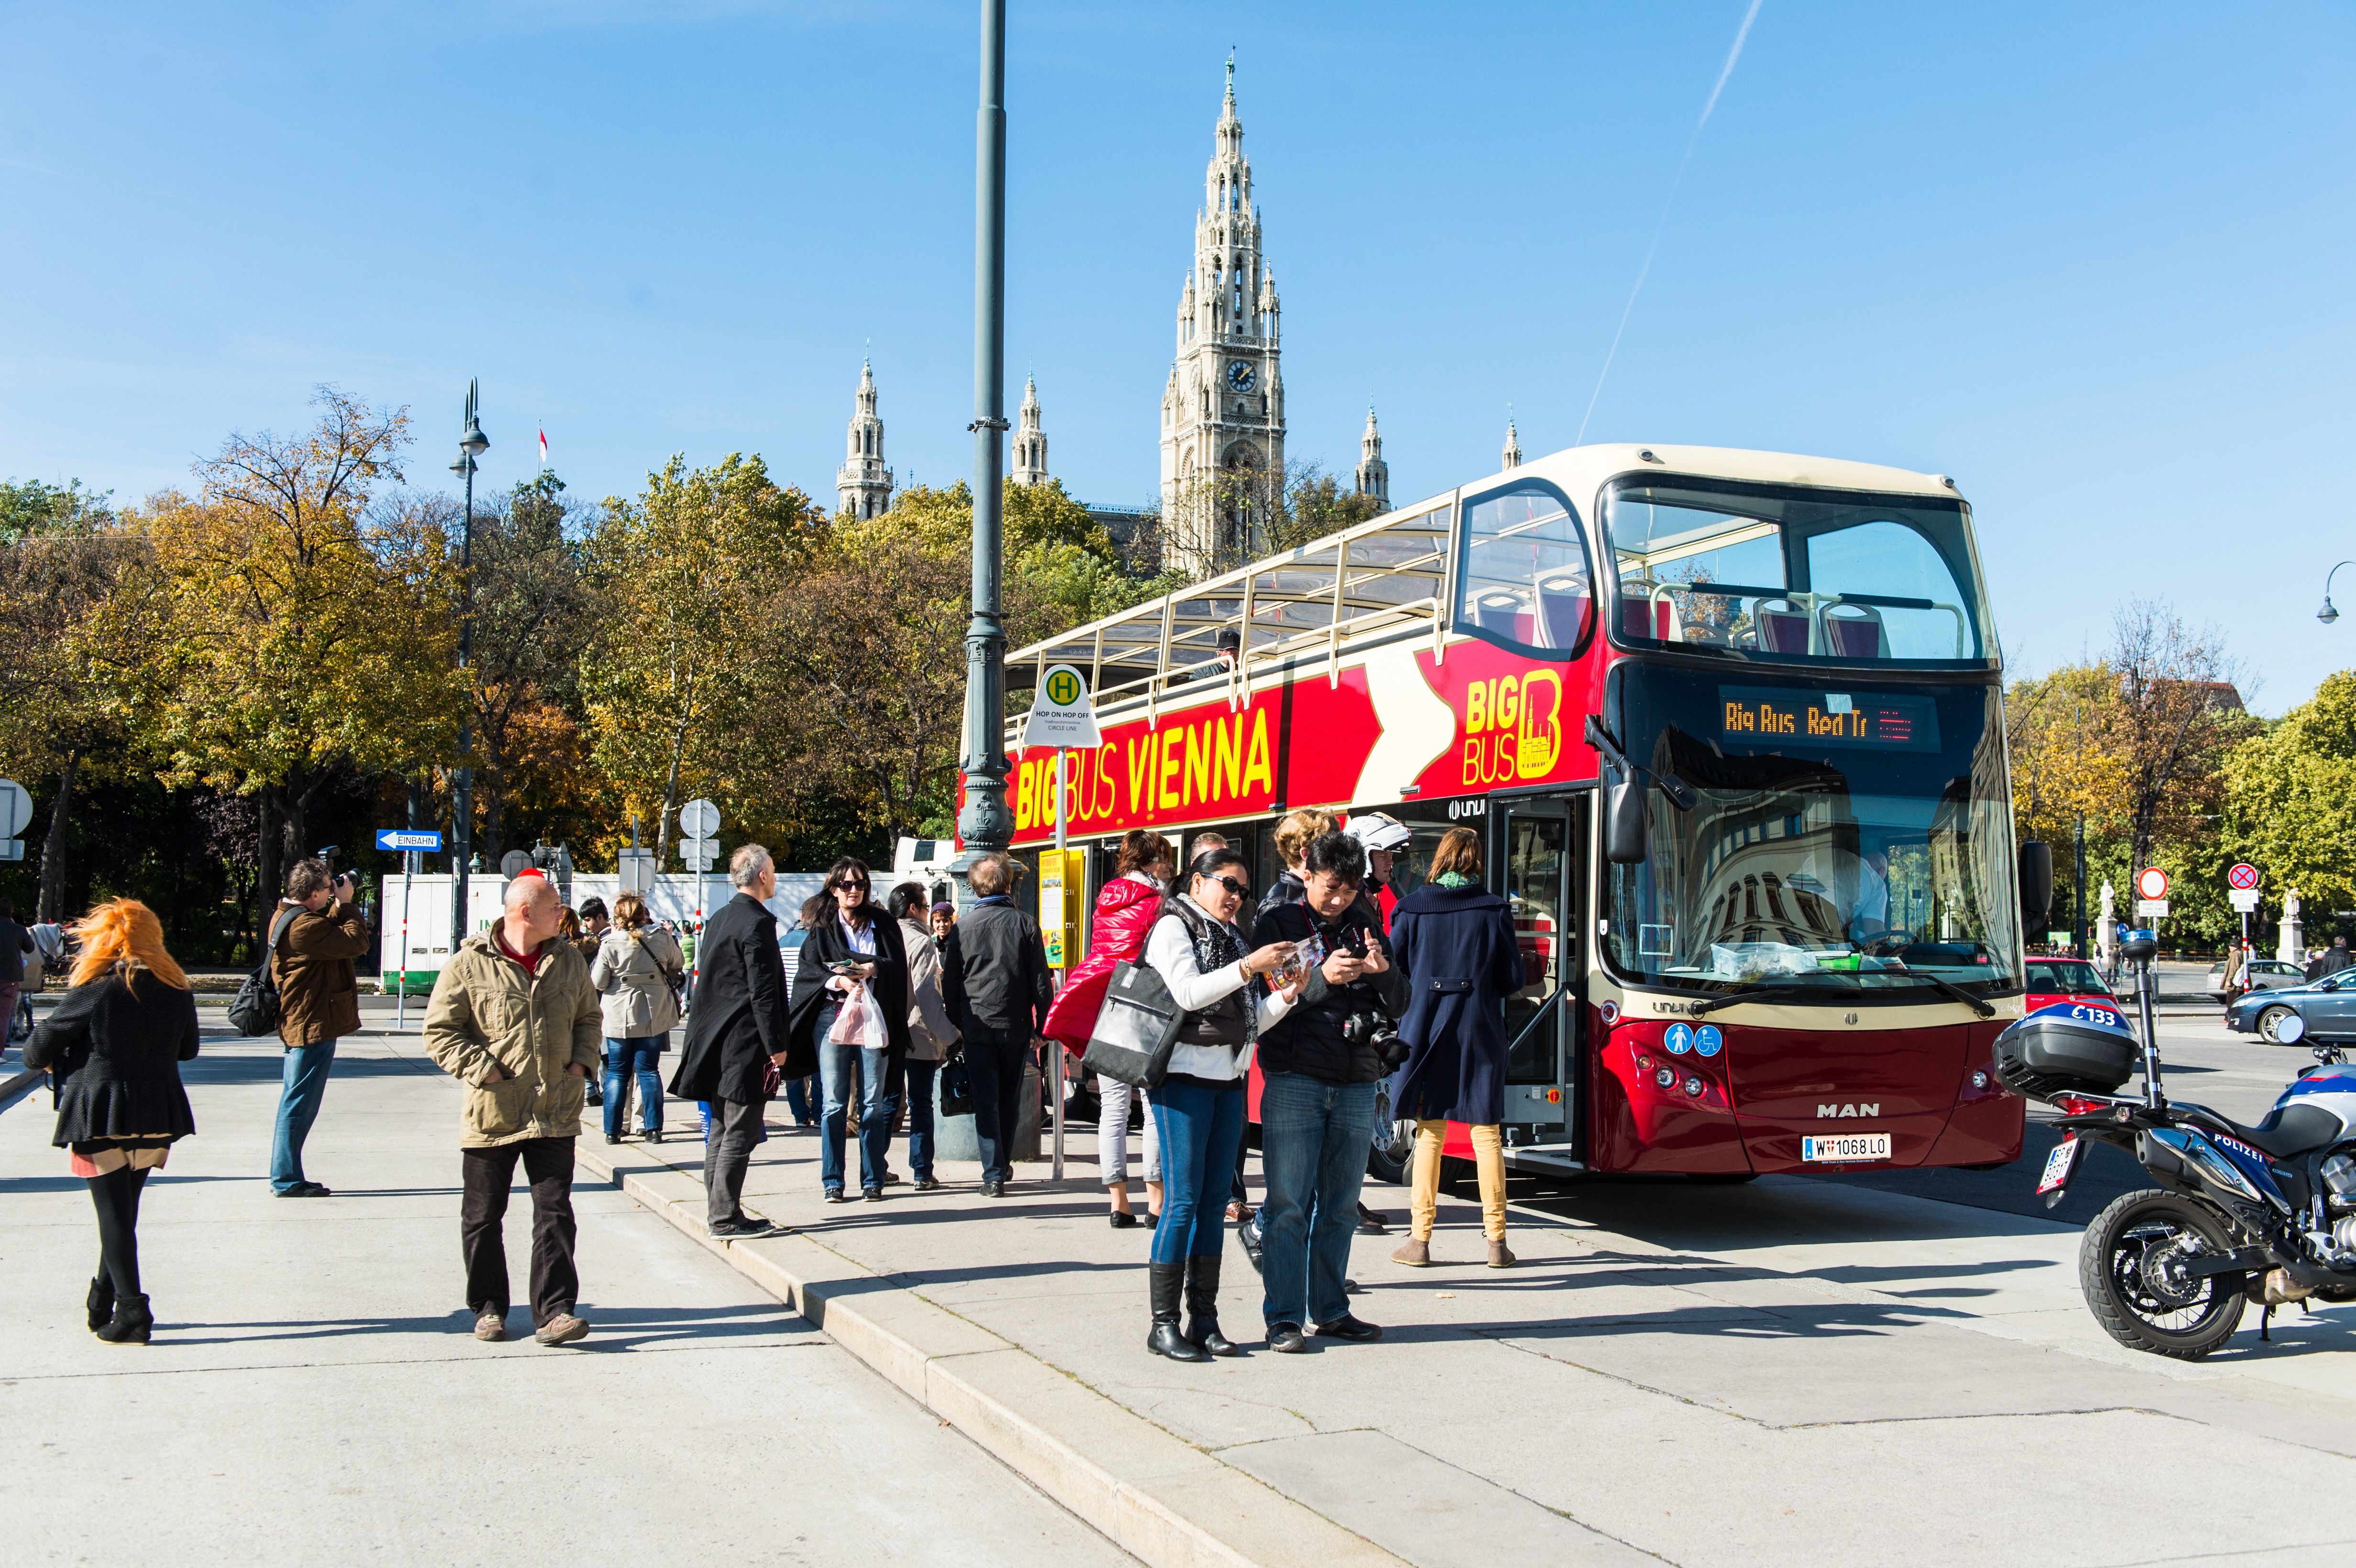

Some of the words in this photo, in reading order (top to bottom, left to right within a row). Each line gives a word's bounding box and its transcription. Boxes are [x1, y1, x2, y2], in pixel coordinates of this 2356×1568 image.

[1466, 675, 1518, 734] BIG
[1463, 733, 1515, 785] BUS
[1015, 755, 1057, 830] BIG
[1066, 742, 1117, 823] BUS
[1128, 708, 1272, 814] VIENNA
[398, 836, 434, 845] EINBAHN
[2086, 1008, 2116, 1026] 133
[1817, 1103, 1879, 1118] MAN
[1816, 1141, 1825, 1156] W
[1836, 1139, 1866, 1155] 1068
[2054, 1147, 2065, 1163] BP
[2214, 1133, 2263, 1163] POLIZEI
[2045, 1161, 2068, 1182] 90317
[2273, 1168, 2292, 1177] HONDA
